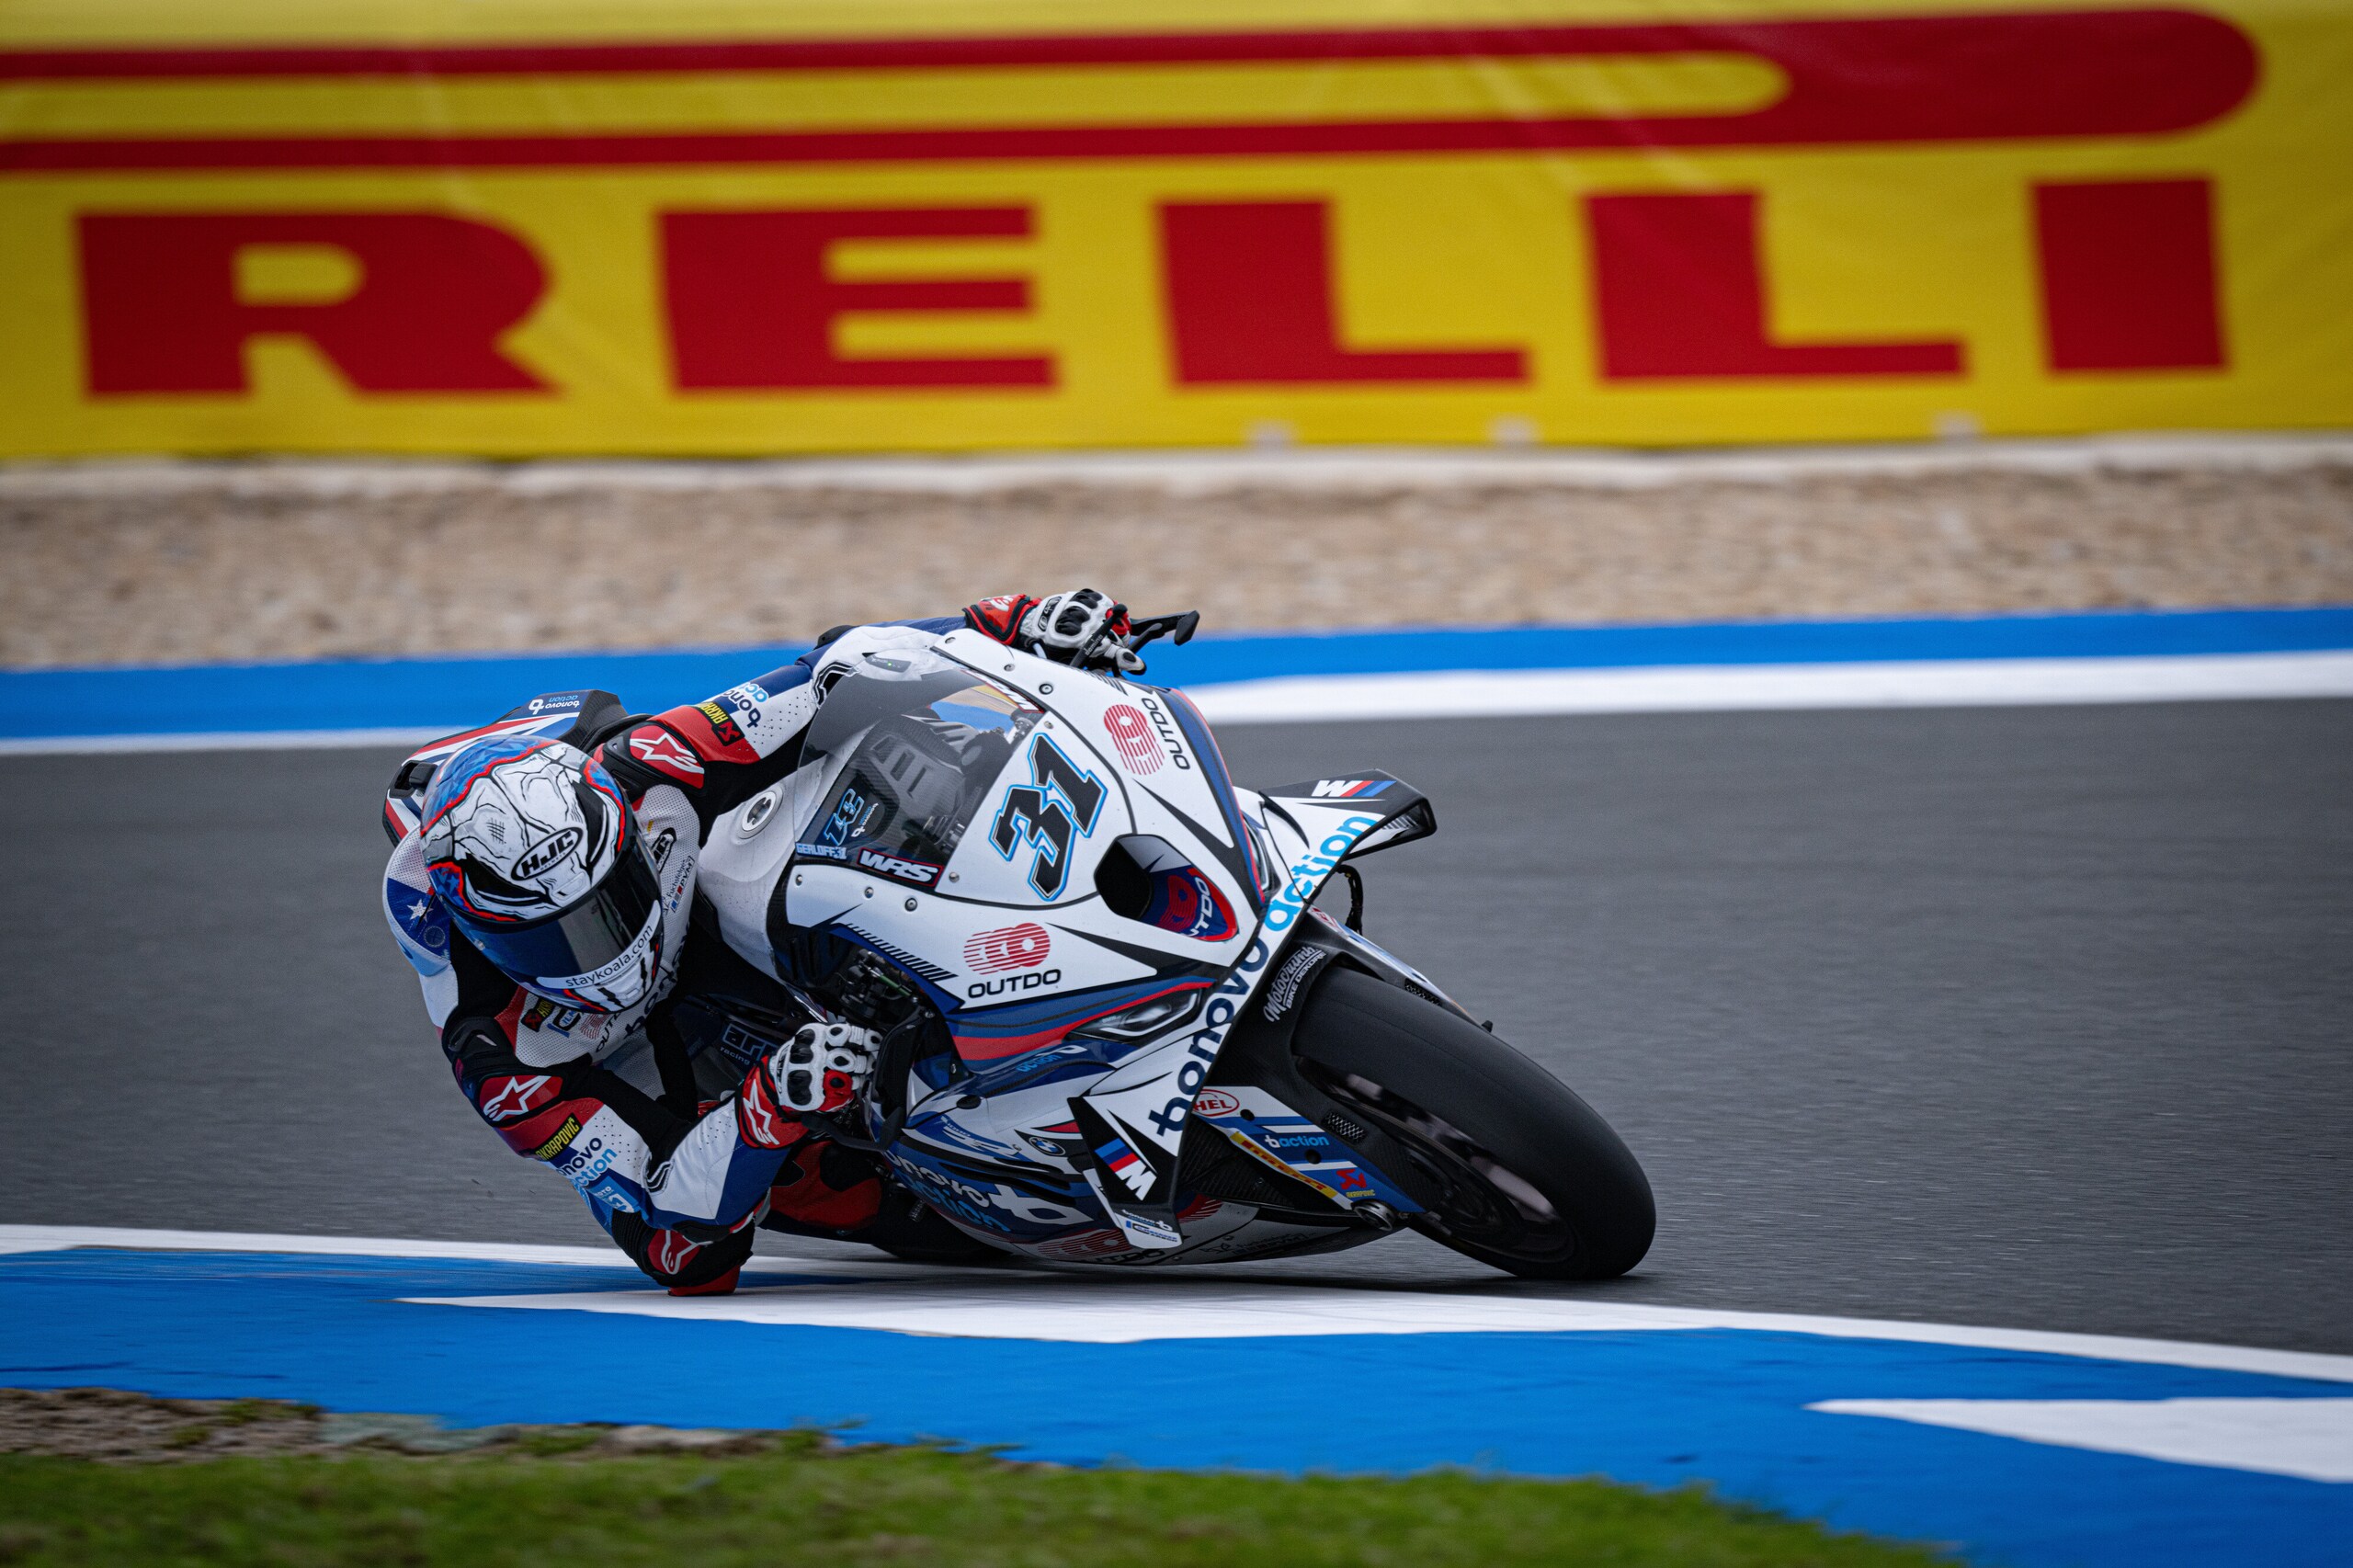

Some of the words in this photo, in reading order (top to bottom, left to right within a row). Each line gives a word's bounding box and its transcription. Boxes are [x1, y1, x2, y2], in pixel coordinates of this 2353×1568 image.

[1142, 698, 1190, 770] OUTDO
[988, 733, 1108, 902] 31
[521, 830, 574, 878] HJC
[859, 850, 938, 882] WRS
[1265, 816, 1378, 931] action
[566, 925, 654, 987] staykoala.com
[968, 969, 1062, 999] OUTDO
[1287, 983, 1299, 1009] BIKE
[720, 1046, 751, 1066] racing
[1148, 938, 1269, 1138] bonovo
[1193, 1099, 1233, 1112] HEL
